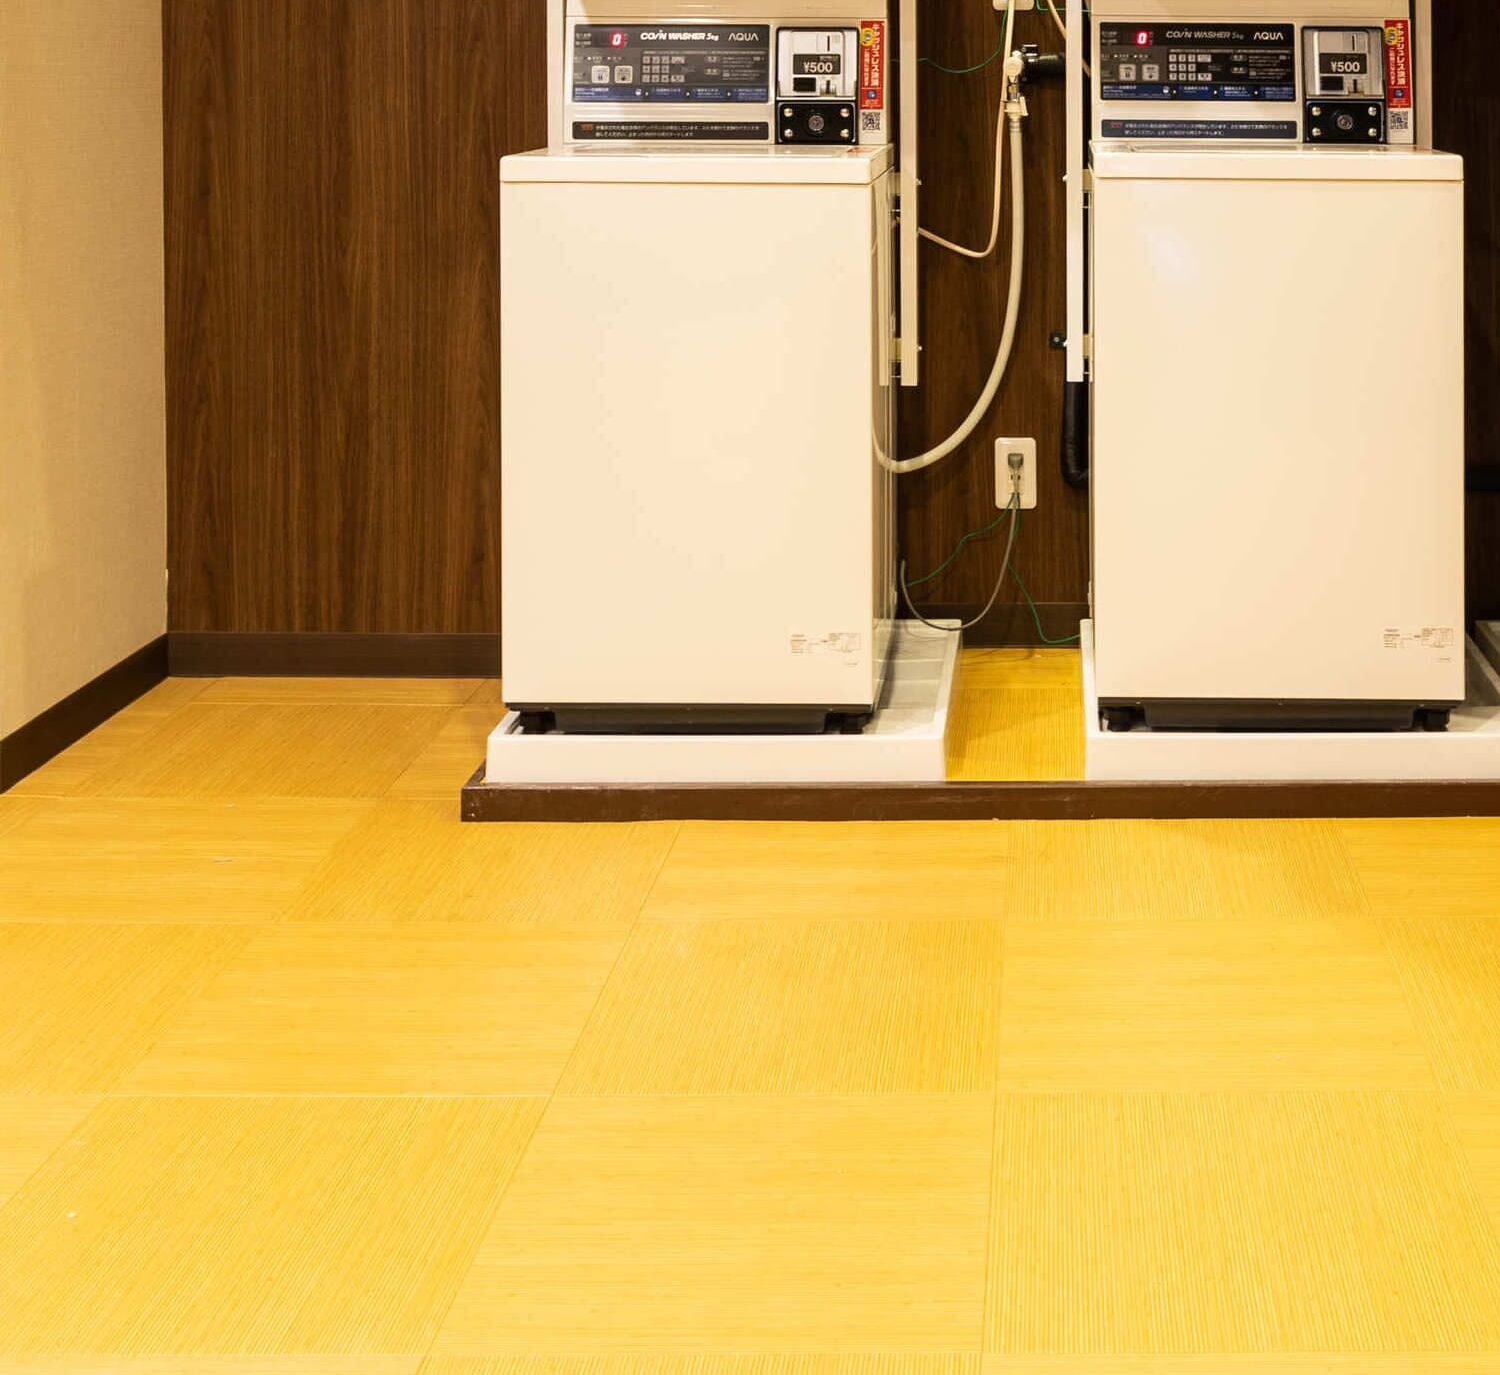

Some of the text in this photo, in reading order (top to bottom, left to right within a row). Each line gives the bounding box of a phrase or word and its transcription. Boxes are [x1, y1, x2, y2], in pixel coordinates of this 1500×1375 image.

[611, 33, 622, 46] 0
[640, 29, 667, 41] COIN
[668, 32, 706, 41] WASHER
[728, 32, 760, 42] AQUA
[1137, 32, 1147, 44] 0
[1166, 28, 1193, 39] COIN
[1193, 30, 1232, 39] WASHER
[1253, 31, 1284, 40] AQUA
[871, 24, 881, 87] キャッシュレス決済
[1396, 23, 1406, 85] キャッシュレス決済
[804, 61, 833, 73] ¥500
[1330, 61, 1360, 72] ¥500
